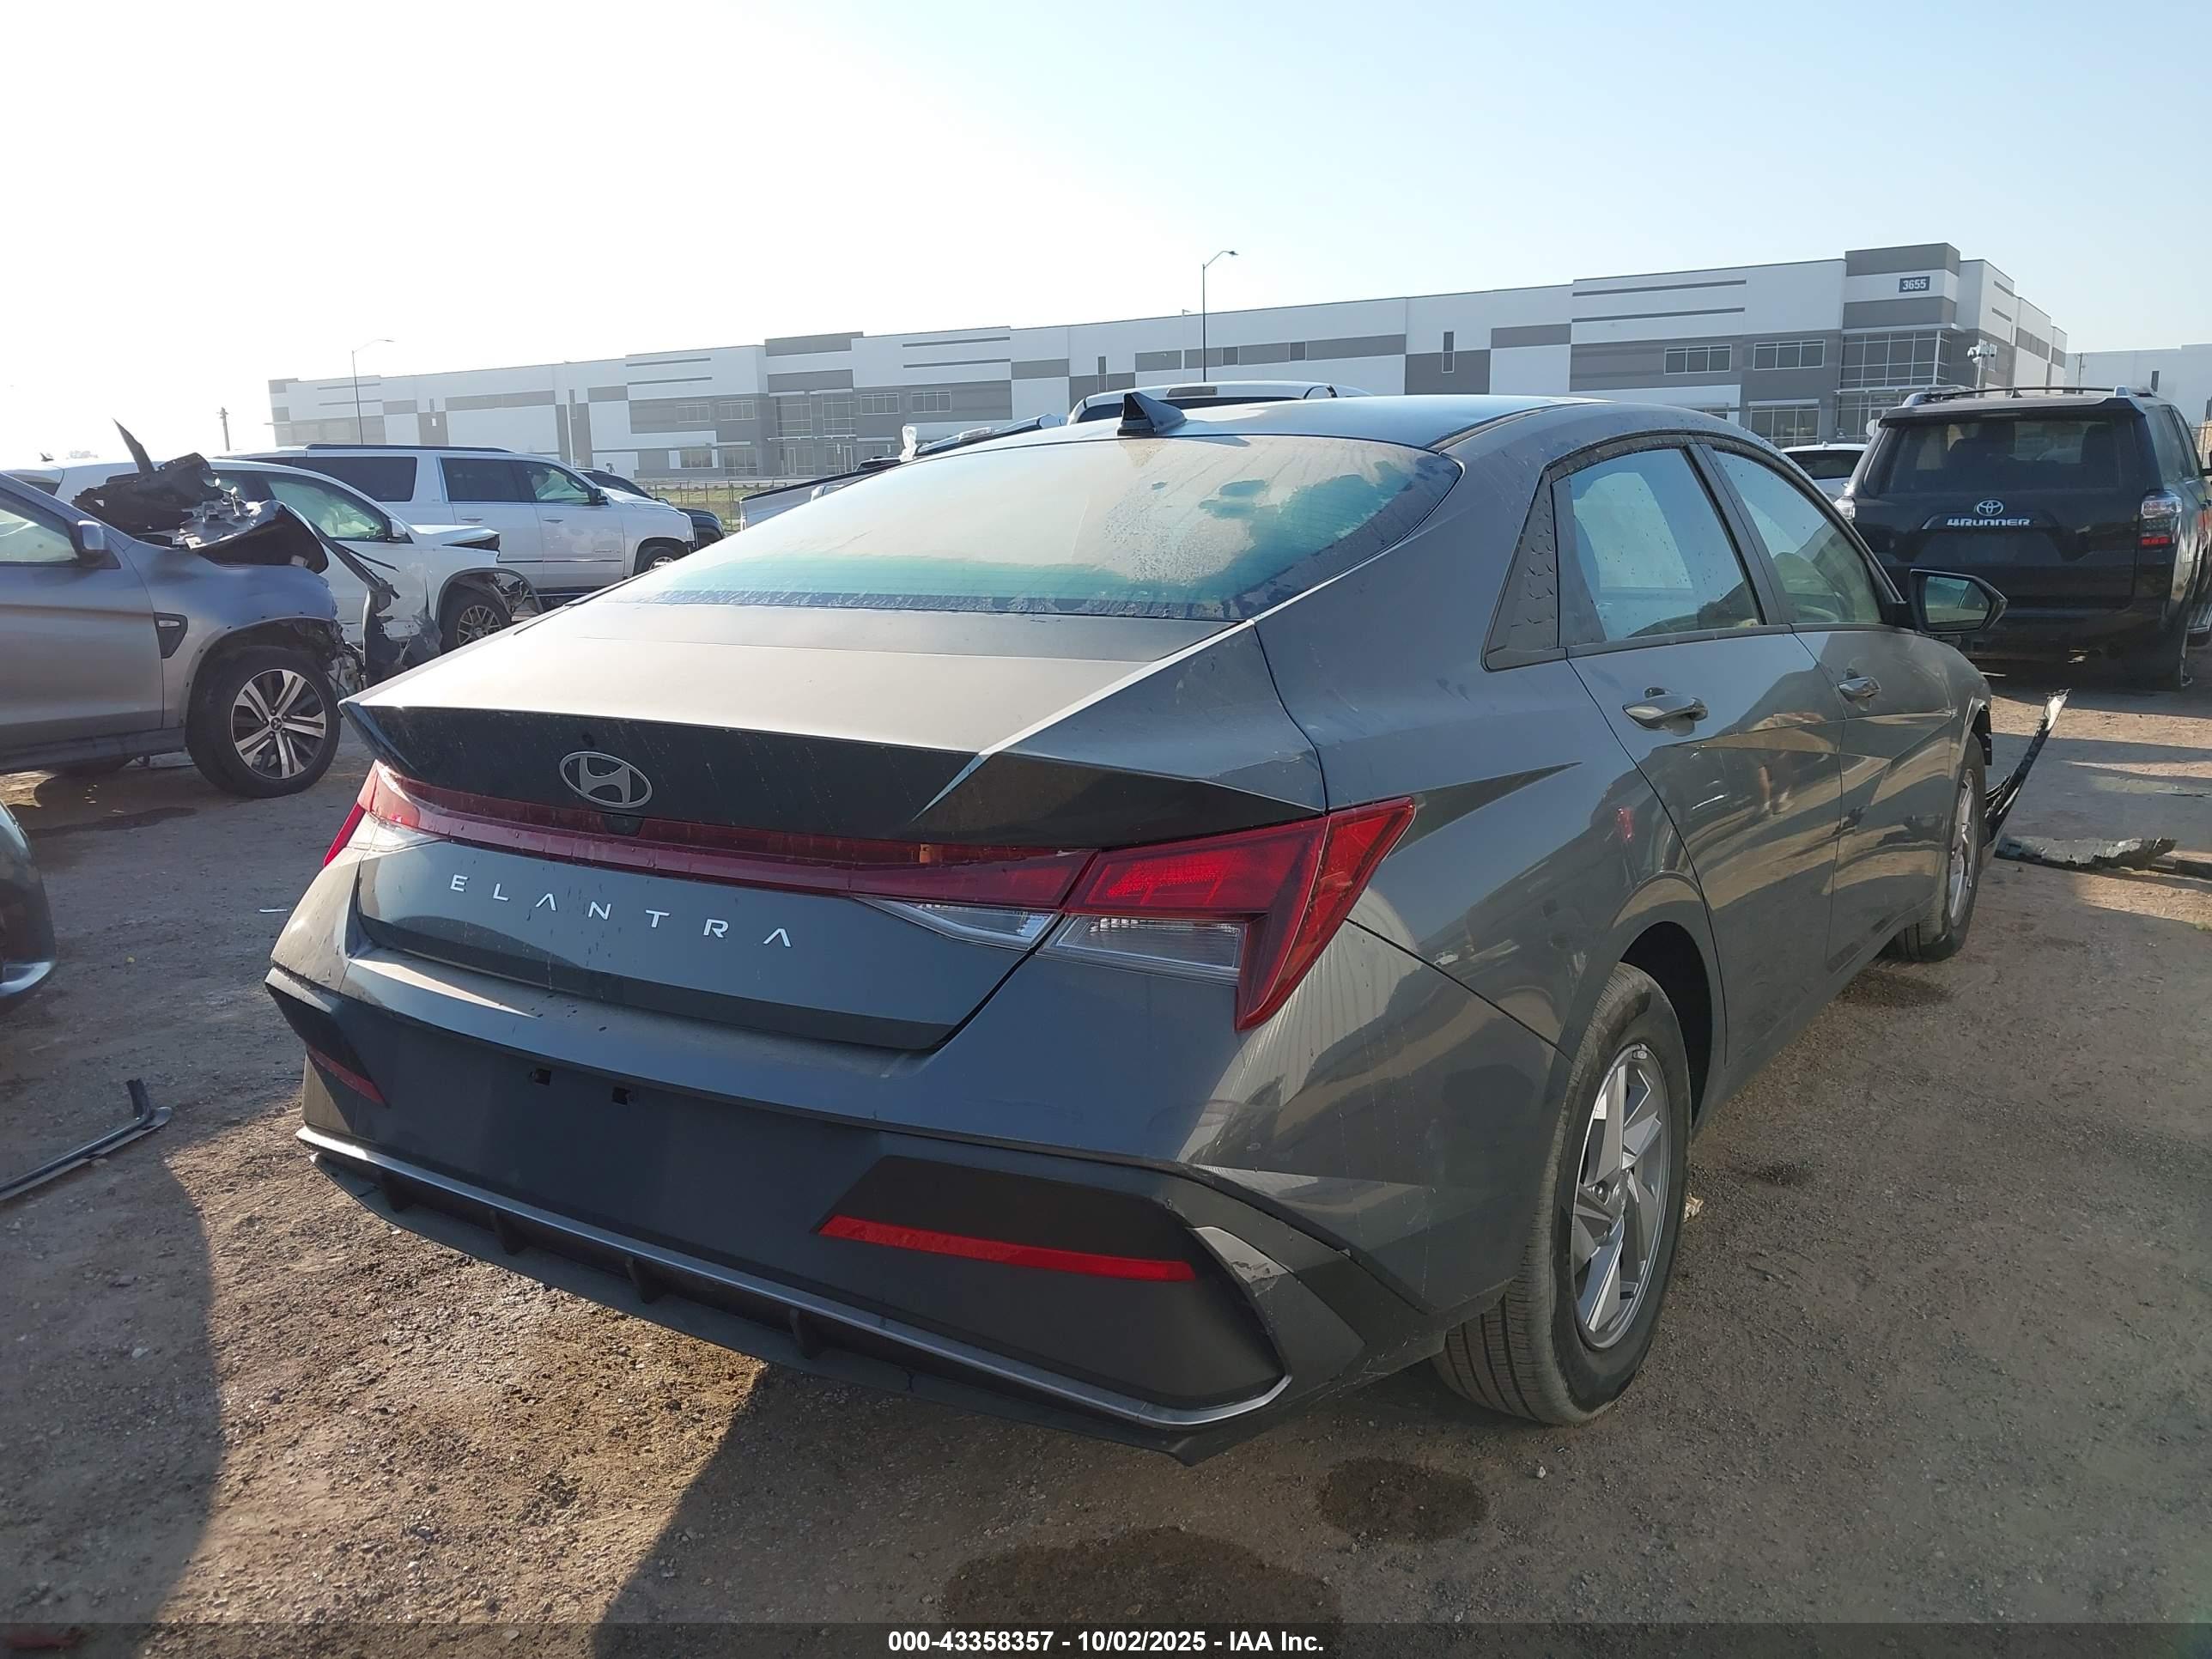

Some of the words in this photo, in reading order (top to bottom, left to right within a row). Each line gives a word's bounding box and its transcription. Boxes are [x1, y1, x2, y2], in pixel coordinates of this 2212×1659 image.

[1902, 278, 1927, 290] 3655
[1947, 518, 2031, 527] 4RUNNER
[449, 873, 792, 948] ELANTRA
